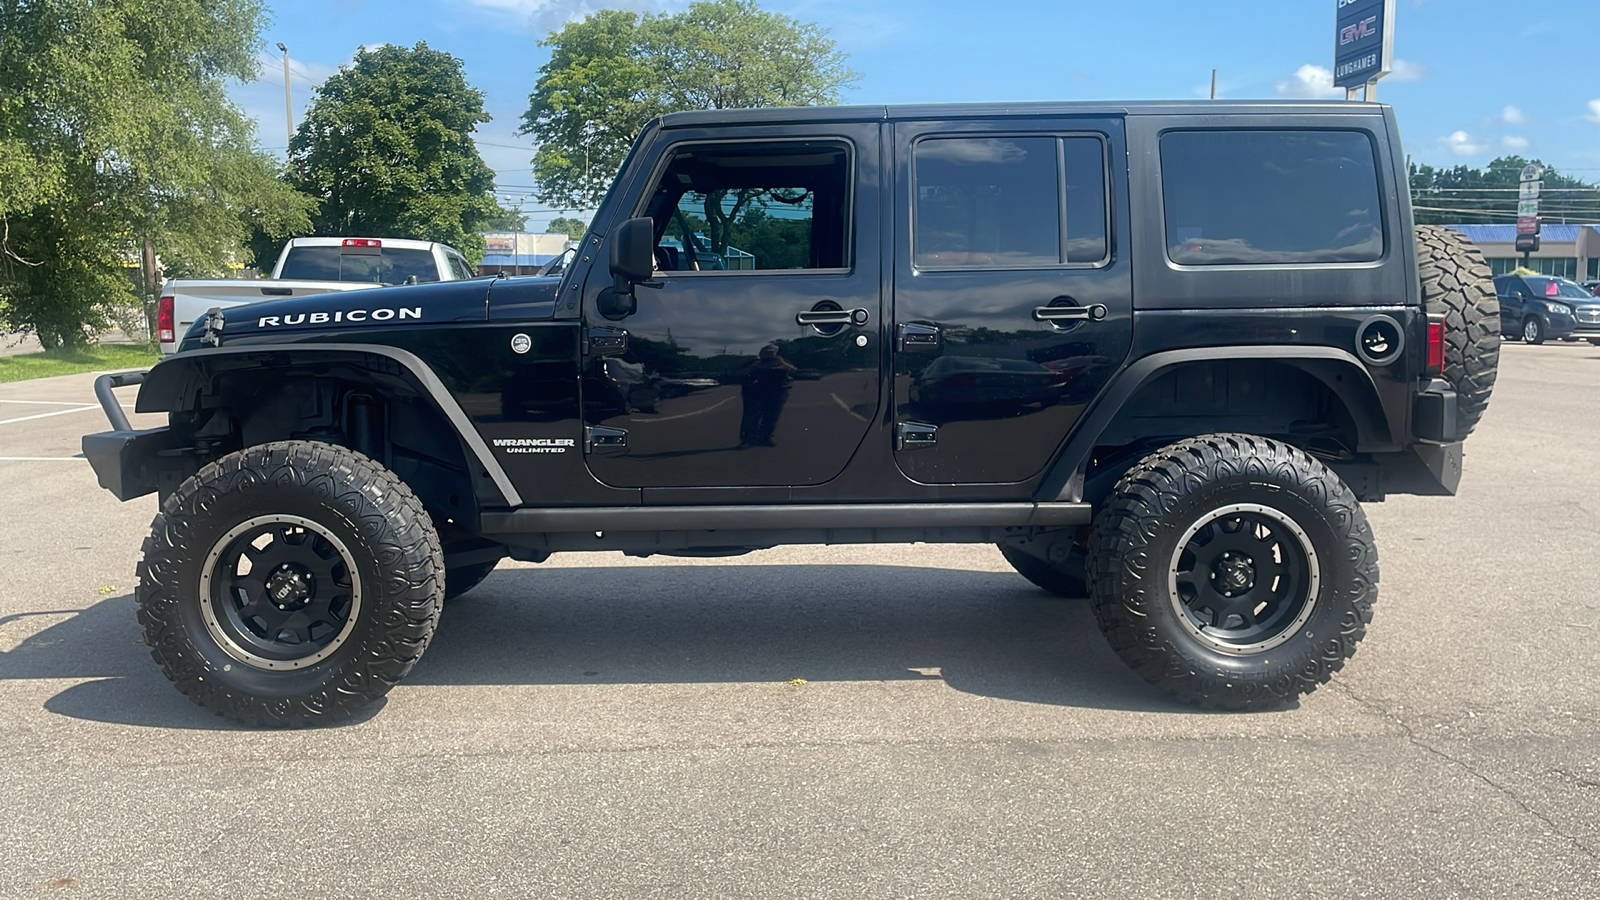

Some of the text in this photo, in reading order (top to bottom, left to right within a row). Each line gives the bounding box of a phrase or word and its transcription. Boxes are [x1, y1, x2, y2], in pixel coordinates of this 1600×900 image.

[1340, 15, 1376, 45] GMC
[258, 307, 422, 328] RUBICON
[493, 439, 575, 447] WRANGLER
